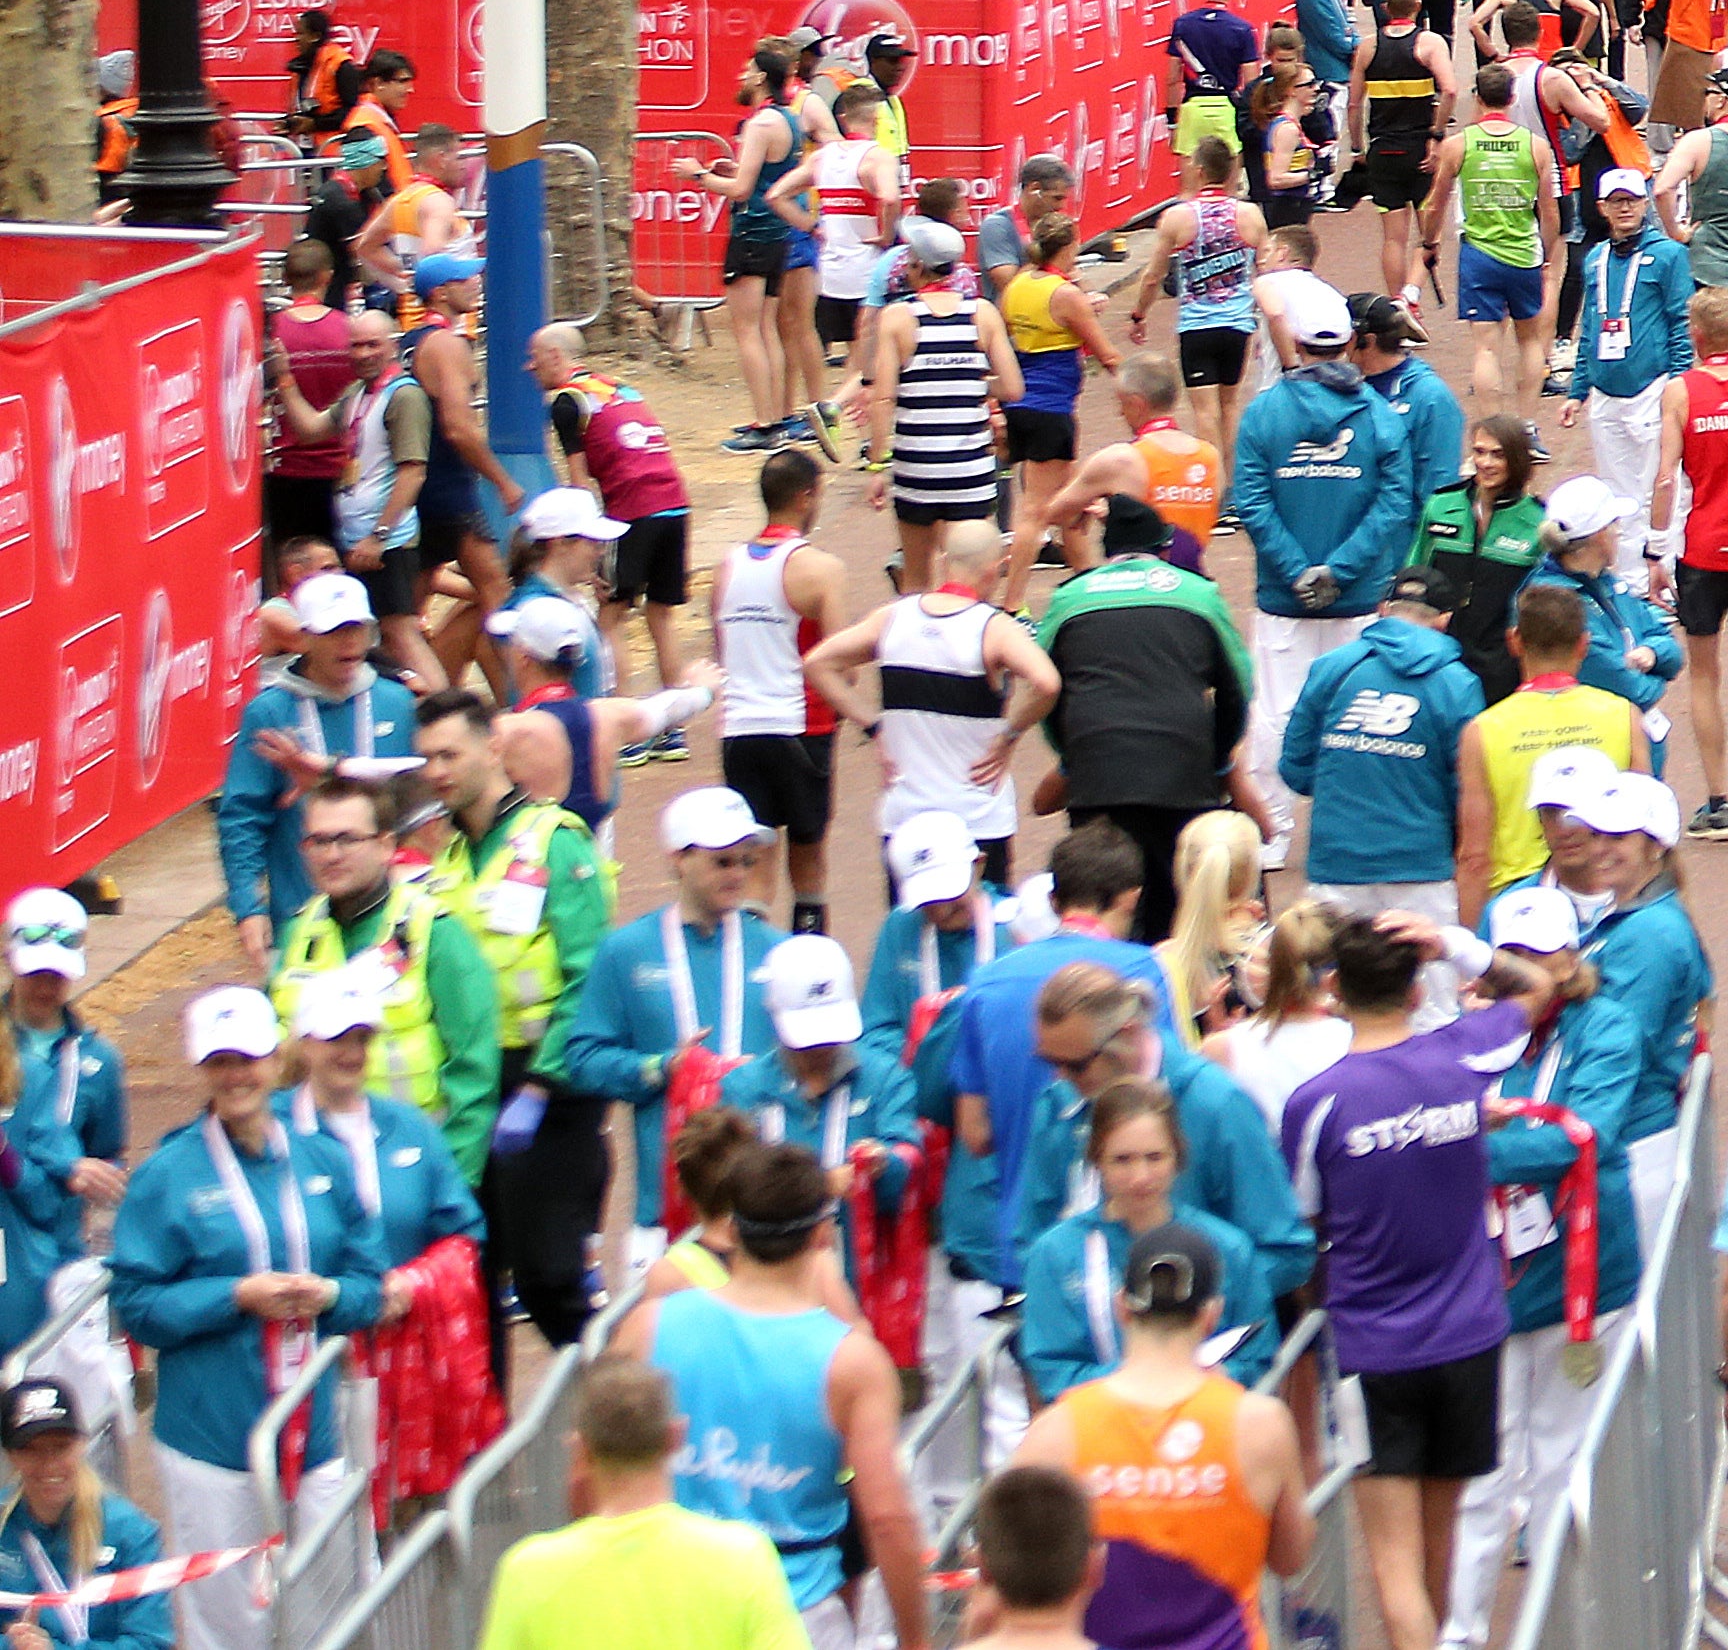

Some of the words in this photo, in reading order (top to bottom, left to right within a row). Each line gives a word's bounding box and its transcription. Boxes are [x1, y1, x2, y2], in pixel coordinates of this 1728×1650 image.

[1475, 139, 1520, 152] PHILPOT
[628, 189, 728, 233] oney
[1155, 485, 1214, 504] sense
[1321, 732, 1360, 750] new
[1360, 734, 1427, 759] balance
[1085, 1464, 1228, 1498] sense
